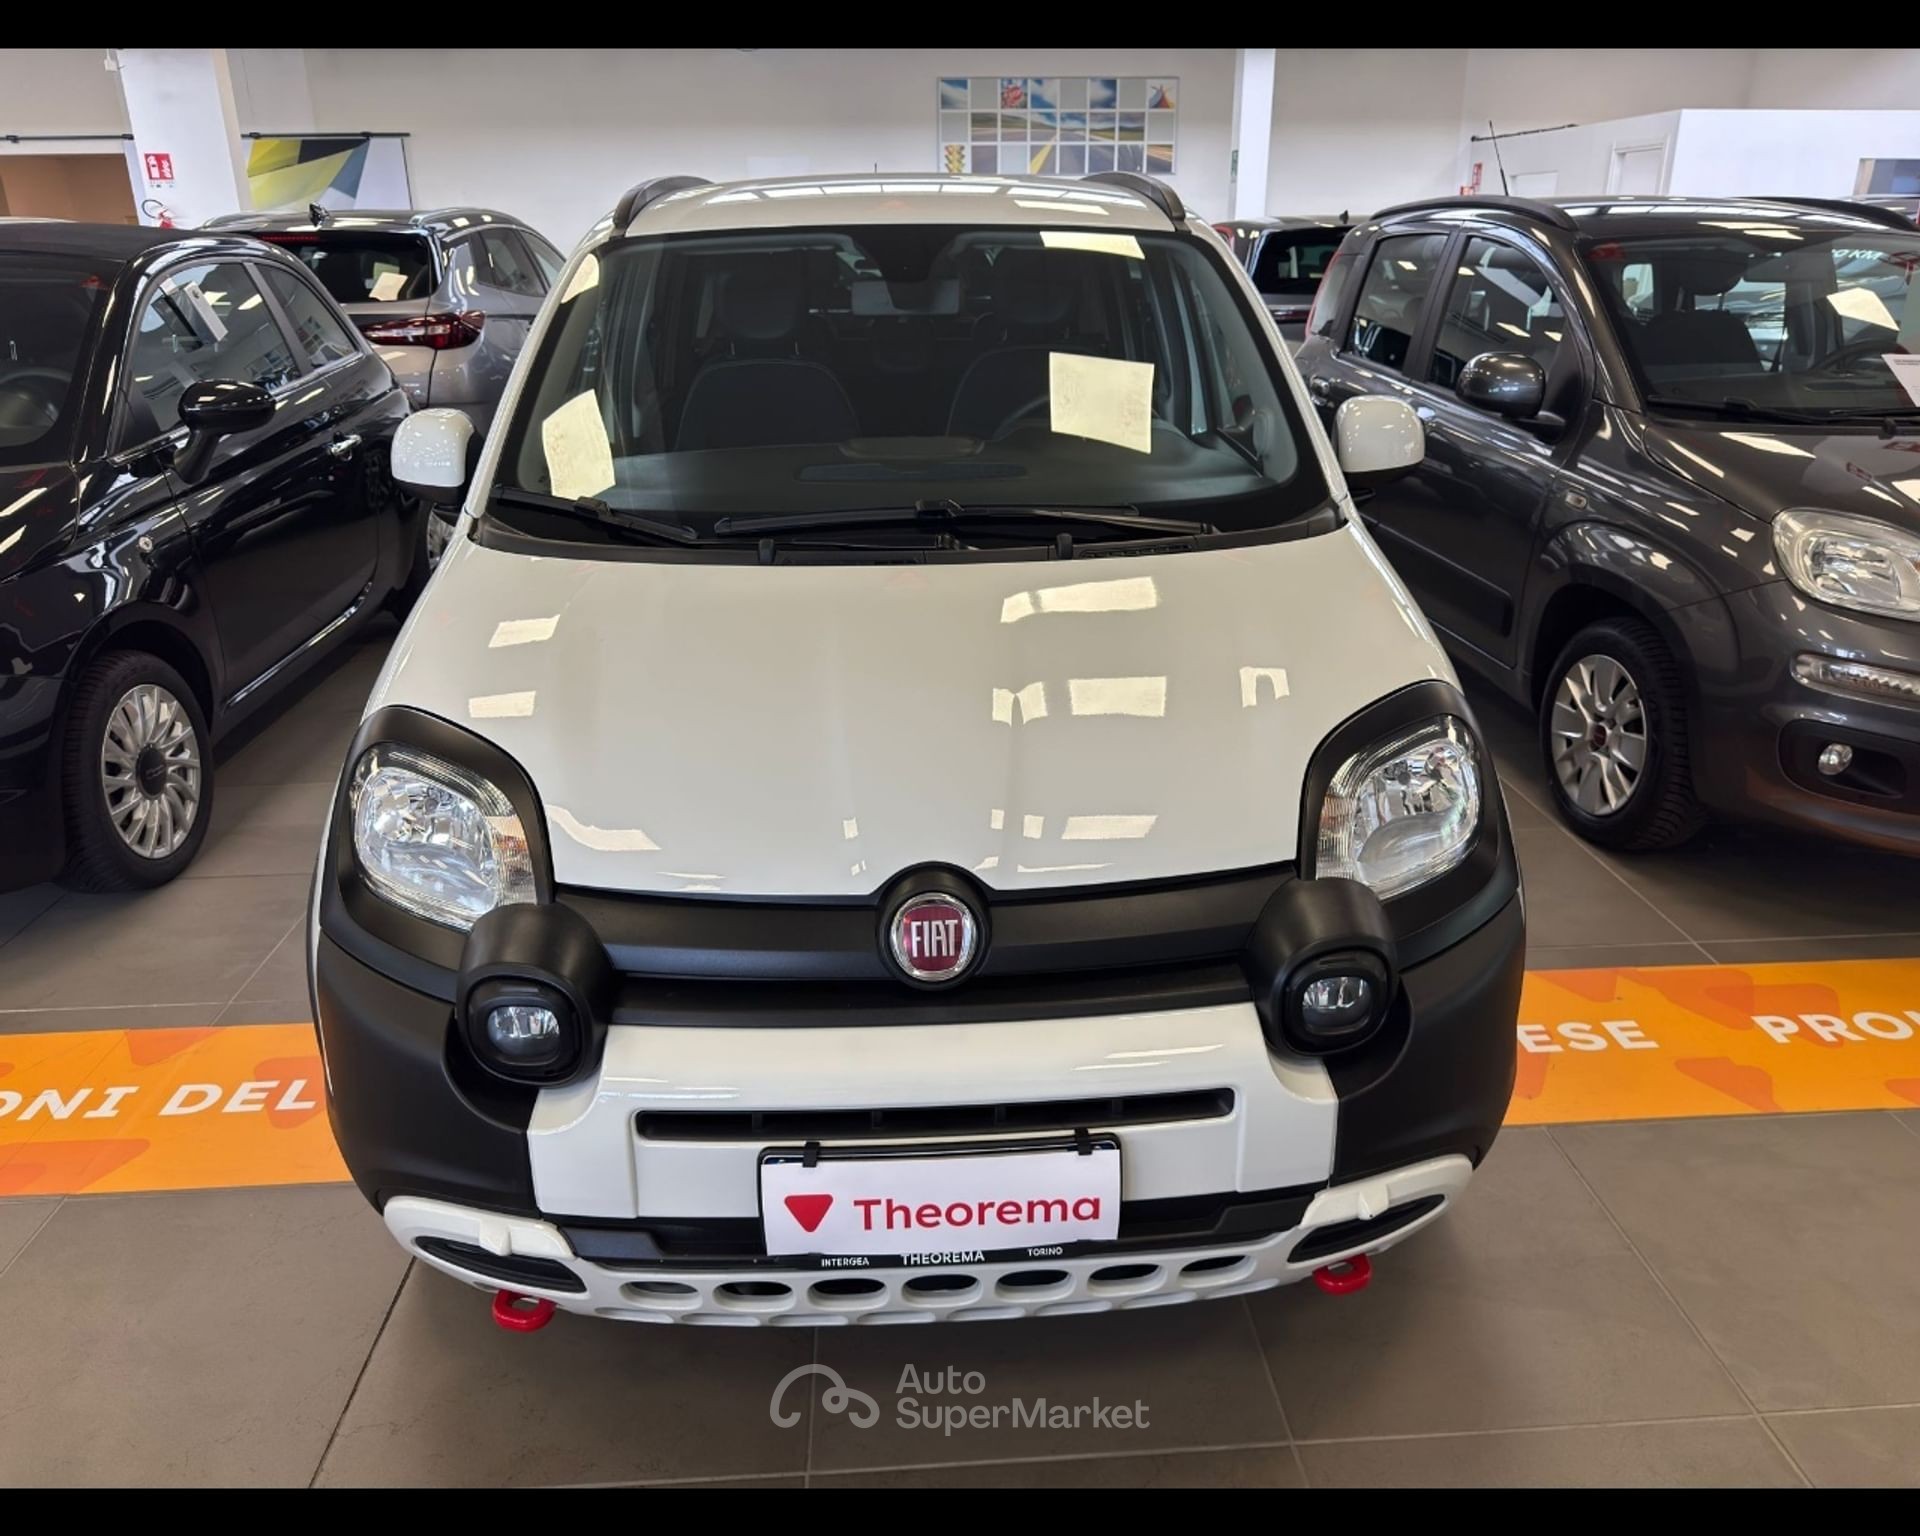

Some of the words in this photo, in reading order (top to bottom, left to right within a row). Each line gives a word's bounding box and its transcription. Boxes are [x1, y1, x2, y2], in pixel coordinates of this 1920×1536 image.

[910, 920, 958, 958] FIAT
[1750, 1010, 1920, 1044] PRO
[158, 1079, 317, 1116] DEL
[853, 1197, 1101, 1231] Theorema
[821, 1256, 870, 1267] INTERGEA
[900, 1249, 985, 1266] THEOREMA
[1027, 1246, 1063, 1257] TORINO
